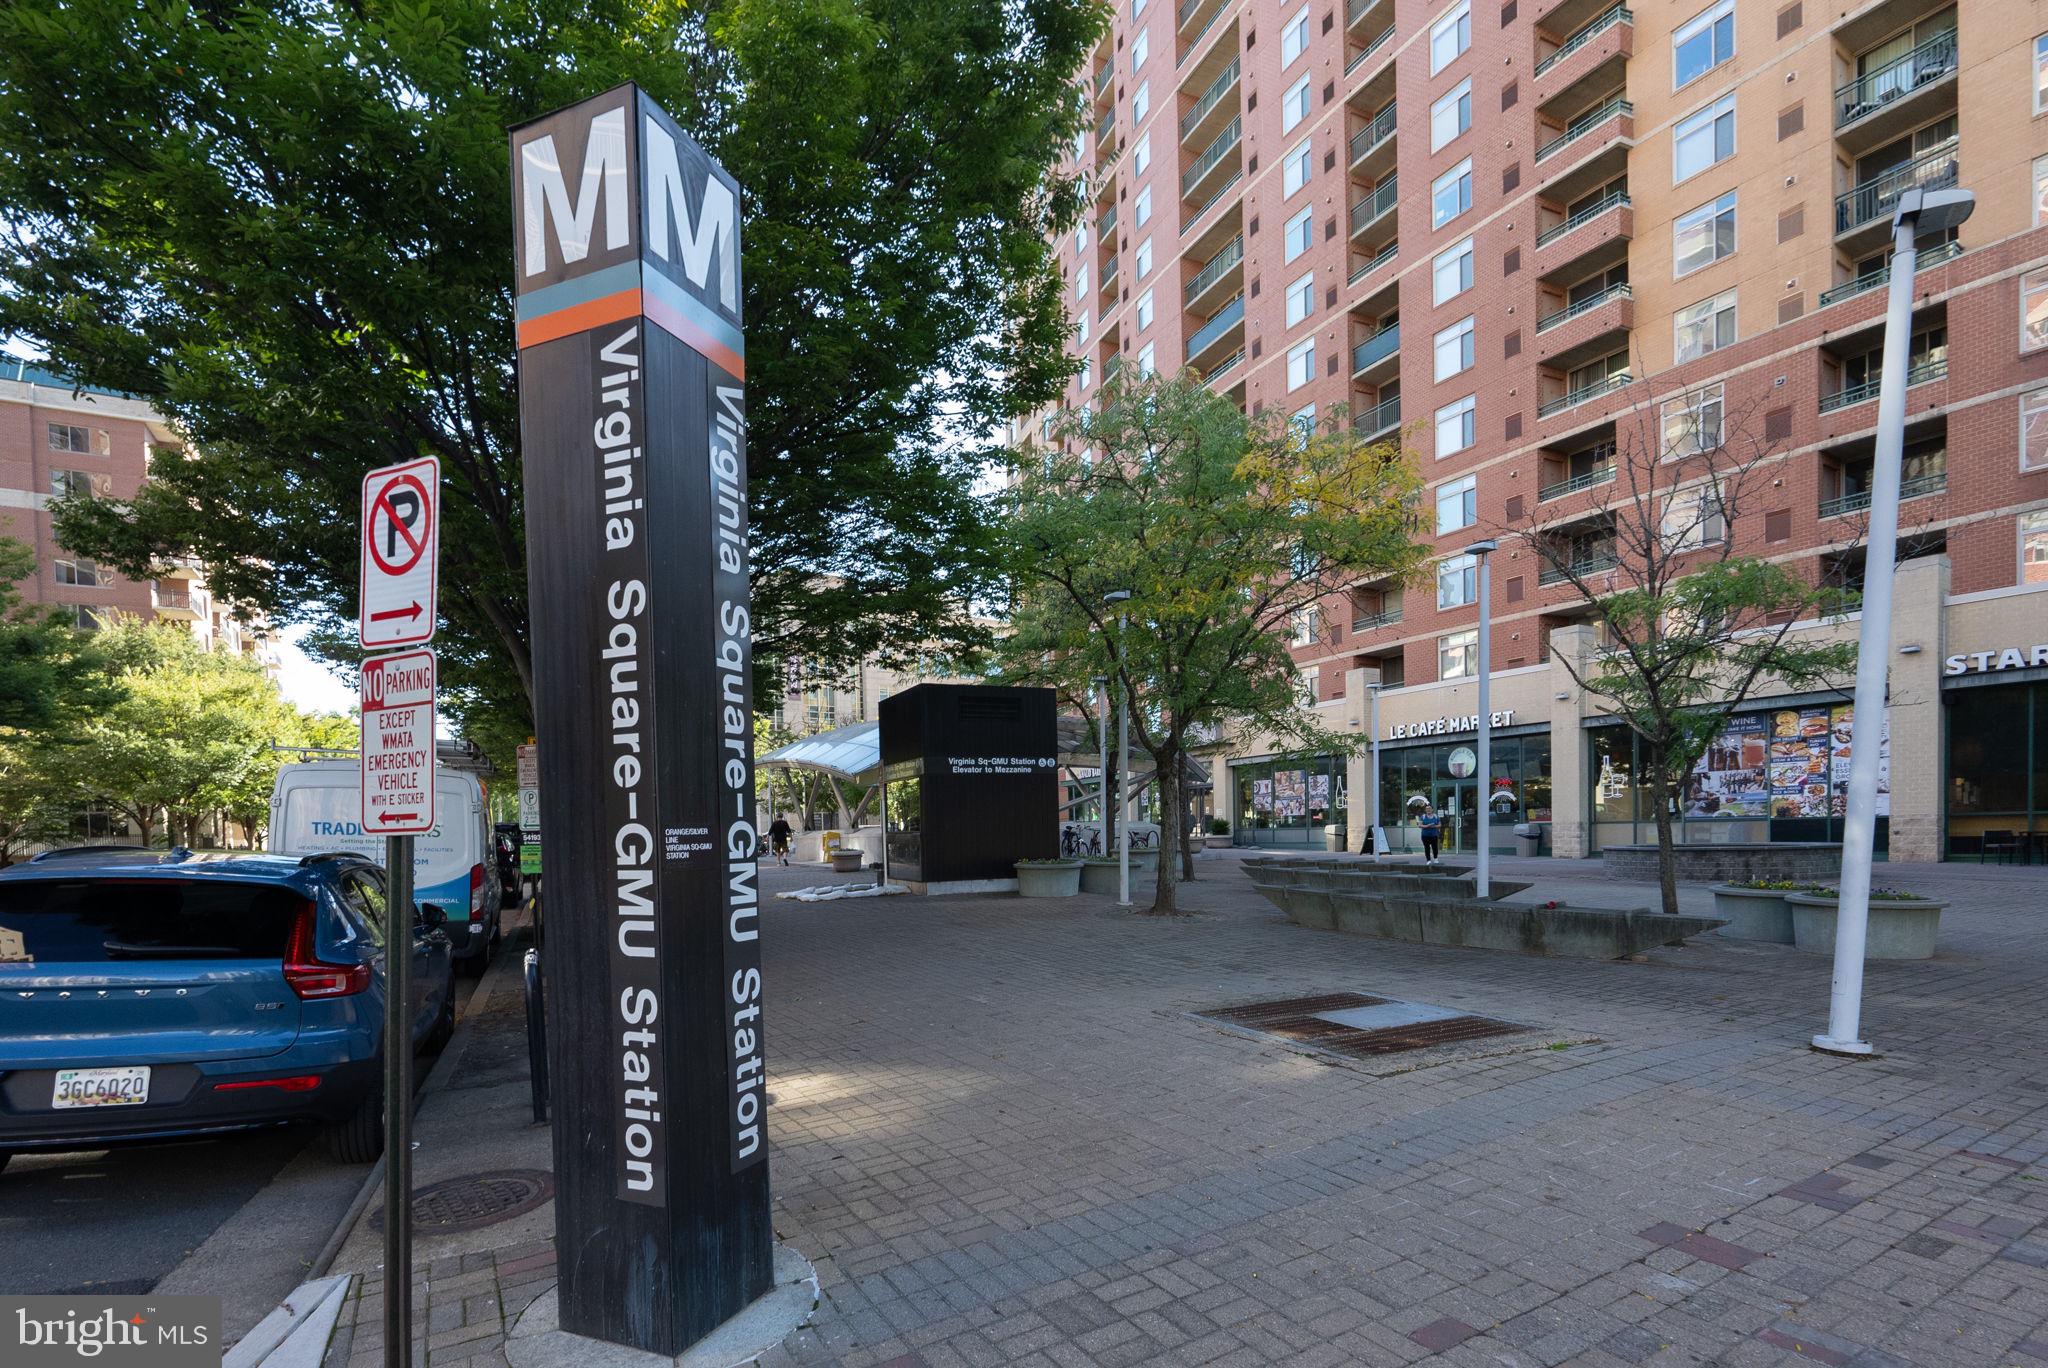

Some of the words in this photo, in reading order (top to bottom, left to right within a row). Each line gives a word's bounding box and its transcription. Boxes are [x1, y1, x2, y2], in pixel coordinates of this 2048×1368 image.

[521, 106, 630, 278] M
[646, 113, 737, 314] M
[594, 325, 643, 551] Virginia
[710, 385, 746, 576] Virginia
[1945, 644, 2048, 675] STAR
[362, 669, 384, 702] NO
[386, 667, 430, 695] PARKING
[379, 709, 416, 730] EXCEPT
[1389, 725, 1407, 740] LE
[1409, 717, 1446, 737] CAFÉ
[1731, 716, 1757, 725] WINE
[382, 731, 413, 749] WMATA
[368, 751, 427, 771] EMERGENCY
[602, 579, 656, 958] Square-GMU
[717, 600, 759, 942] Square-GMU
[948, 757, 975, 765] Virginia
[978, 757, 1008, 766] Sq-GMU
[1010, 757, 1036, 765] Station
[378, 772, 418, 791] VEHICLE
[371, 796, 386, 806] WITH
[397, 792, 425, 805] STICKER
[665, 828, 708, 836] ORANGE/SILVER
[665, 836, 679, 844] LINE
[732, 967, 764, 1159] Station
[58, 1077, 145, 1100] 3GC6020
[620, 986, 661, 1191] Station
